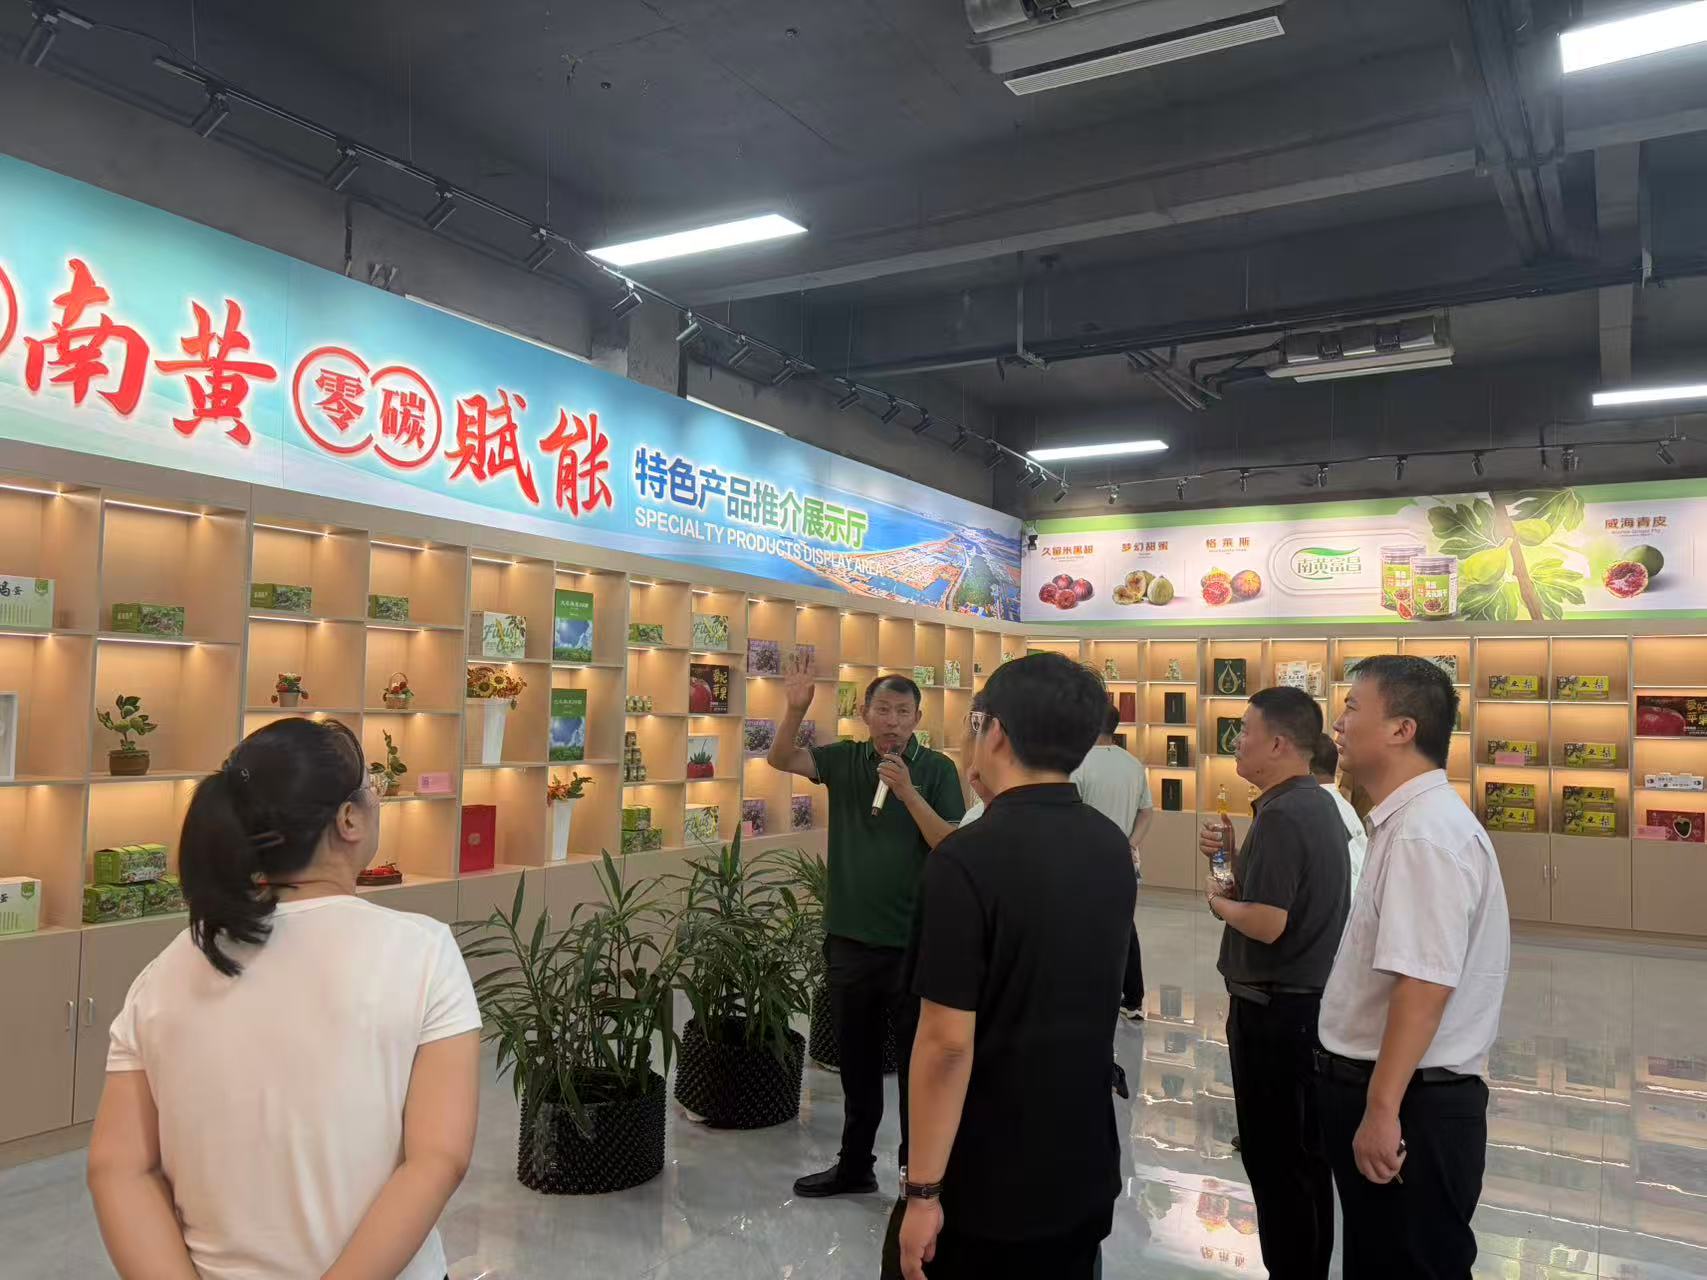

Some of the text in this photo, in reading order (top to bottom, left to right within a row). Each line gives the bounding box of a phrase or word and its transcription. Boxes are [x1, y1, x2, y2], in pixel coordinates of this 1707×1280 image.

[635, 447, 868, 549] 特色产品推介展示厅
[634, 506, 884, 577] SPECIALTY PRODUCTS DISPLAY AREA
[1604, 516, 1668, 529] 威海青皮
[1121, 541, 1169, 552] 梦幻甜蜜
